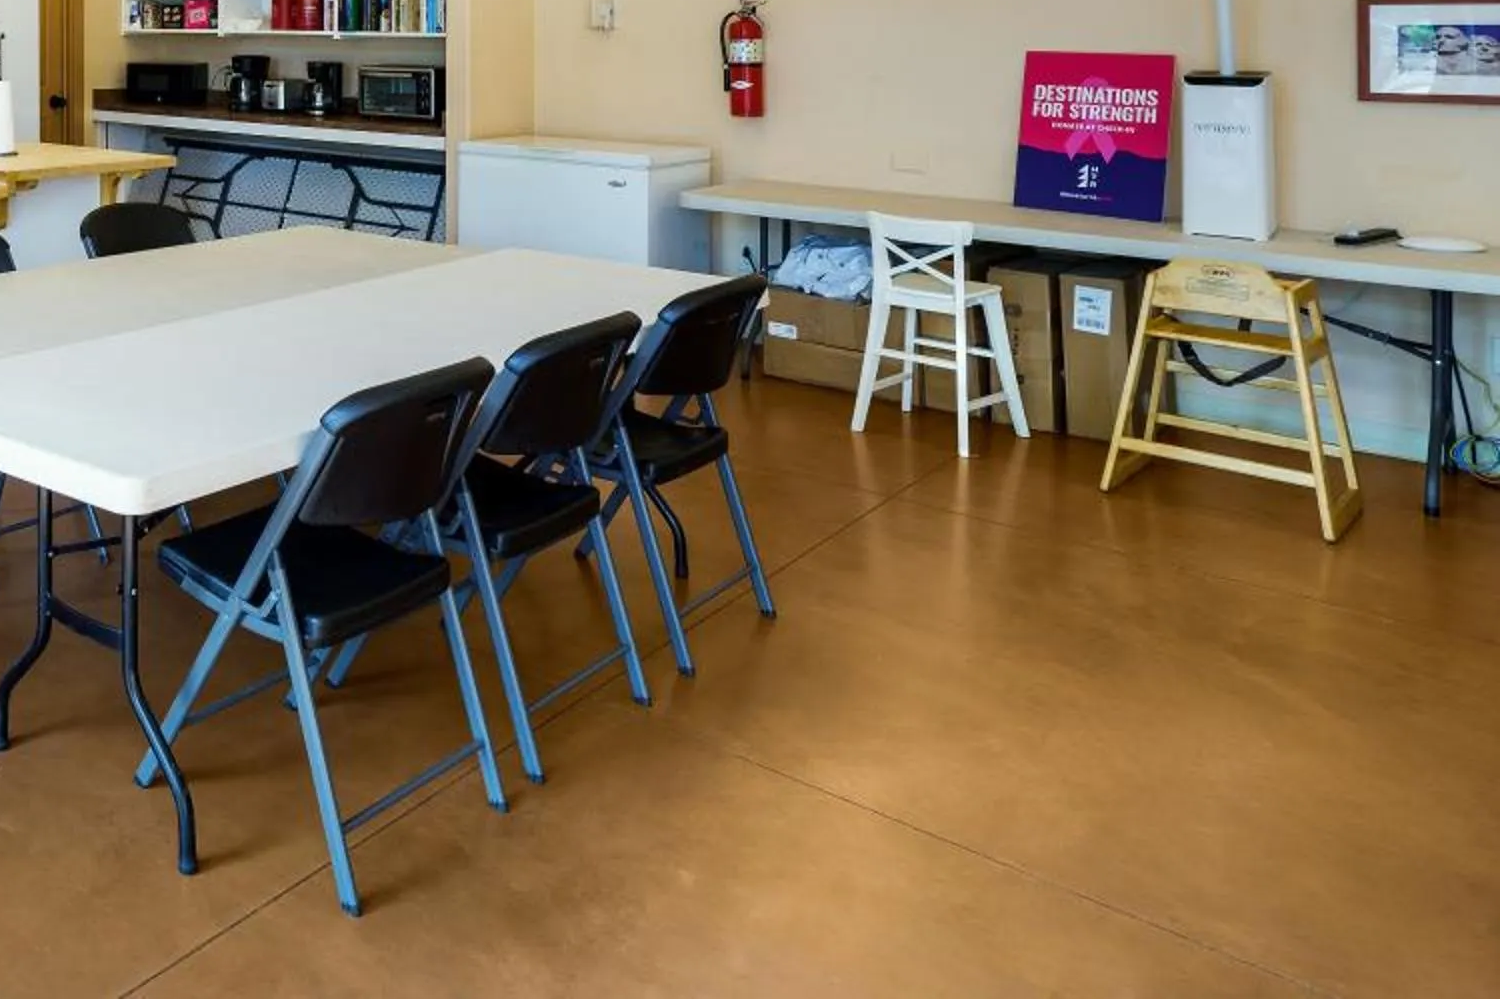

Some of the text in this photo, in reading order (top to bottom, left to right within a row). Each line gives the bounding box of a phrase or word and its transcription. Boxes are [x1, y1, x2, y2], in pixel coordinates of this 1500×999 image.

[1033, 84, 1160, 106] DESTINATIONS
[1032, 101, 1158, 124] FOR STRENGTH
